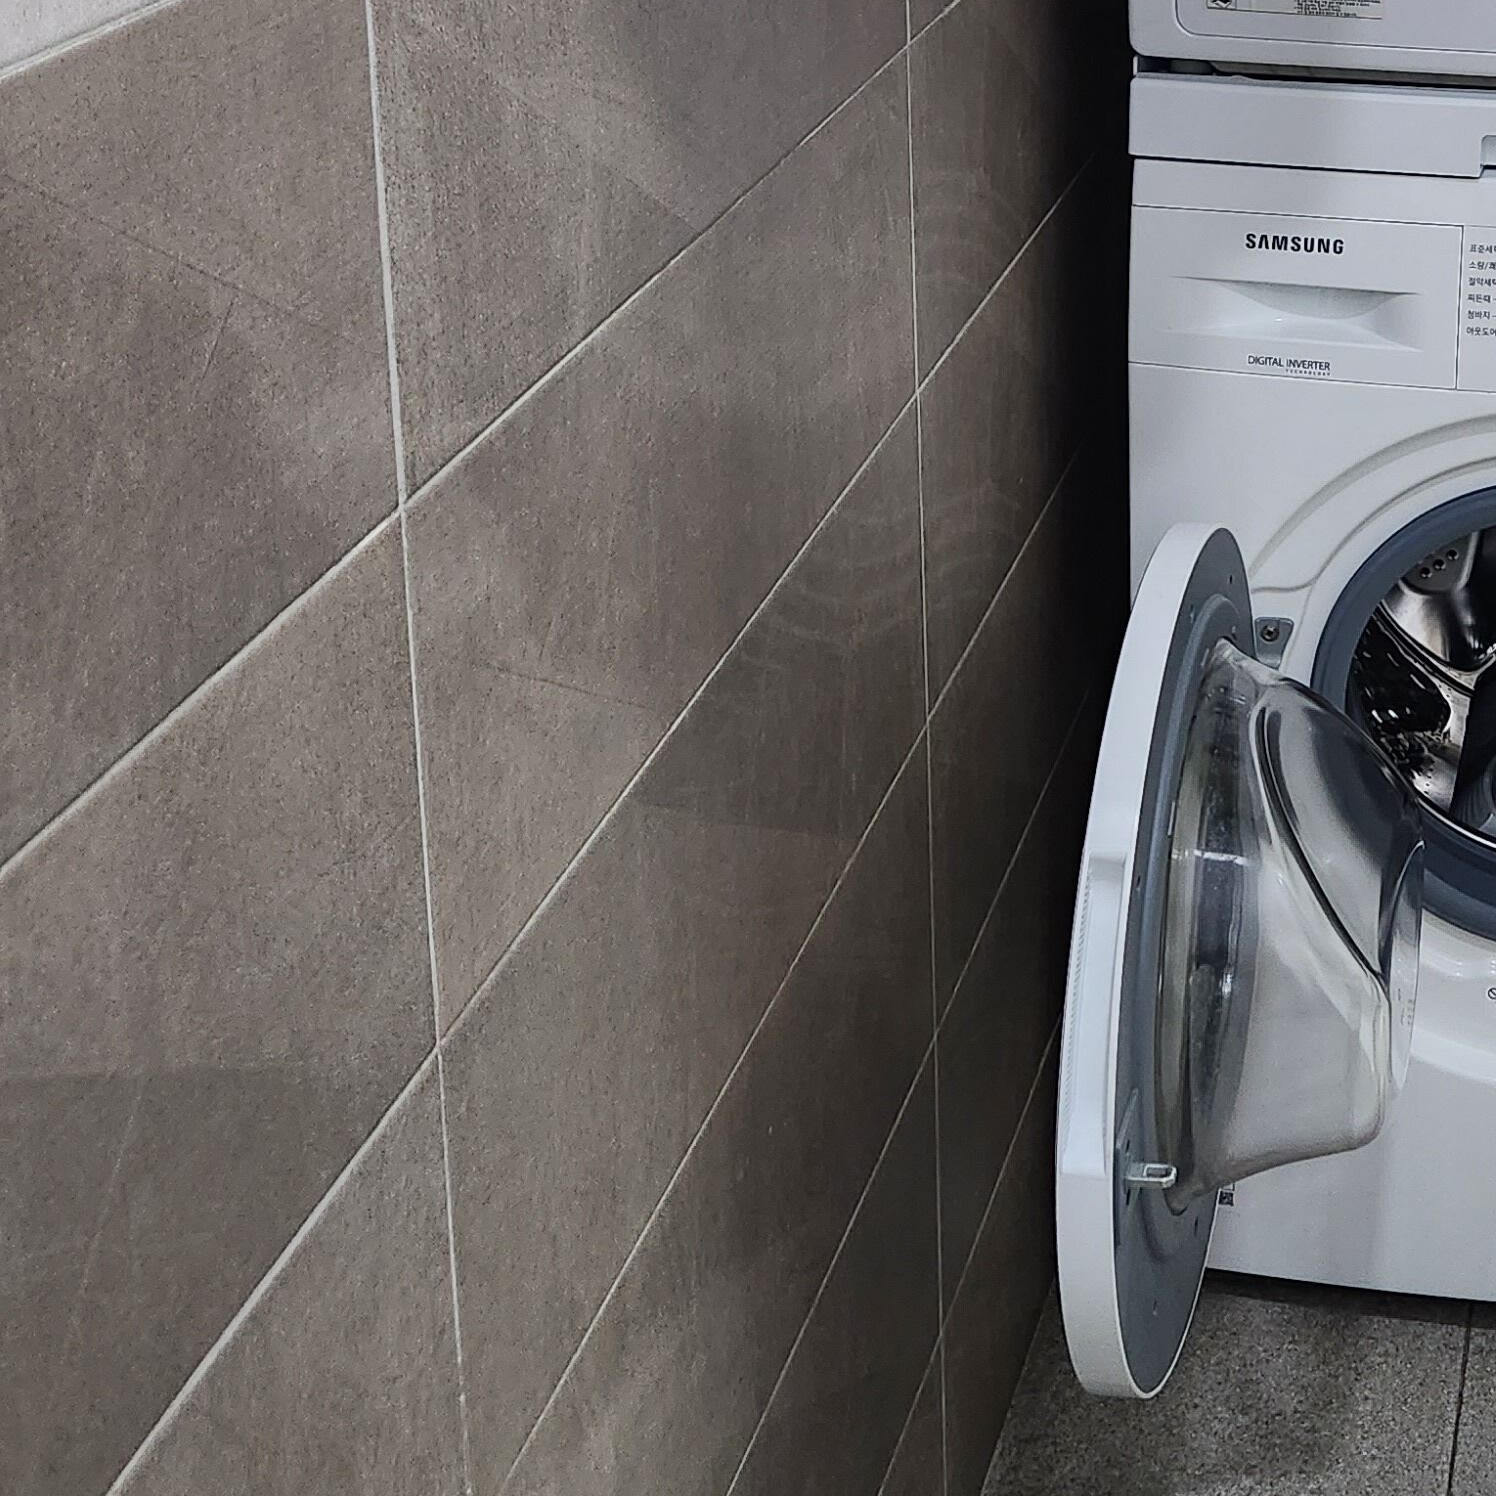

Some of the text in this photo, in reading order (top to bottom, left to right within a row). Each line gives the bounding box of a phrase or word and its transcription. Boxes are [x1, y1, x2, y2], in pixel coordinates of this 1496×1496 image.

[1245, 233, 1344, 255] SAMSUNG
[1467, 293, 1491, 304] 찌든때
[1467, 309, 1491, 320] 청바지
[1248, 355, 1331, 371] DIGITAL INVERTER
